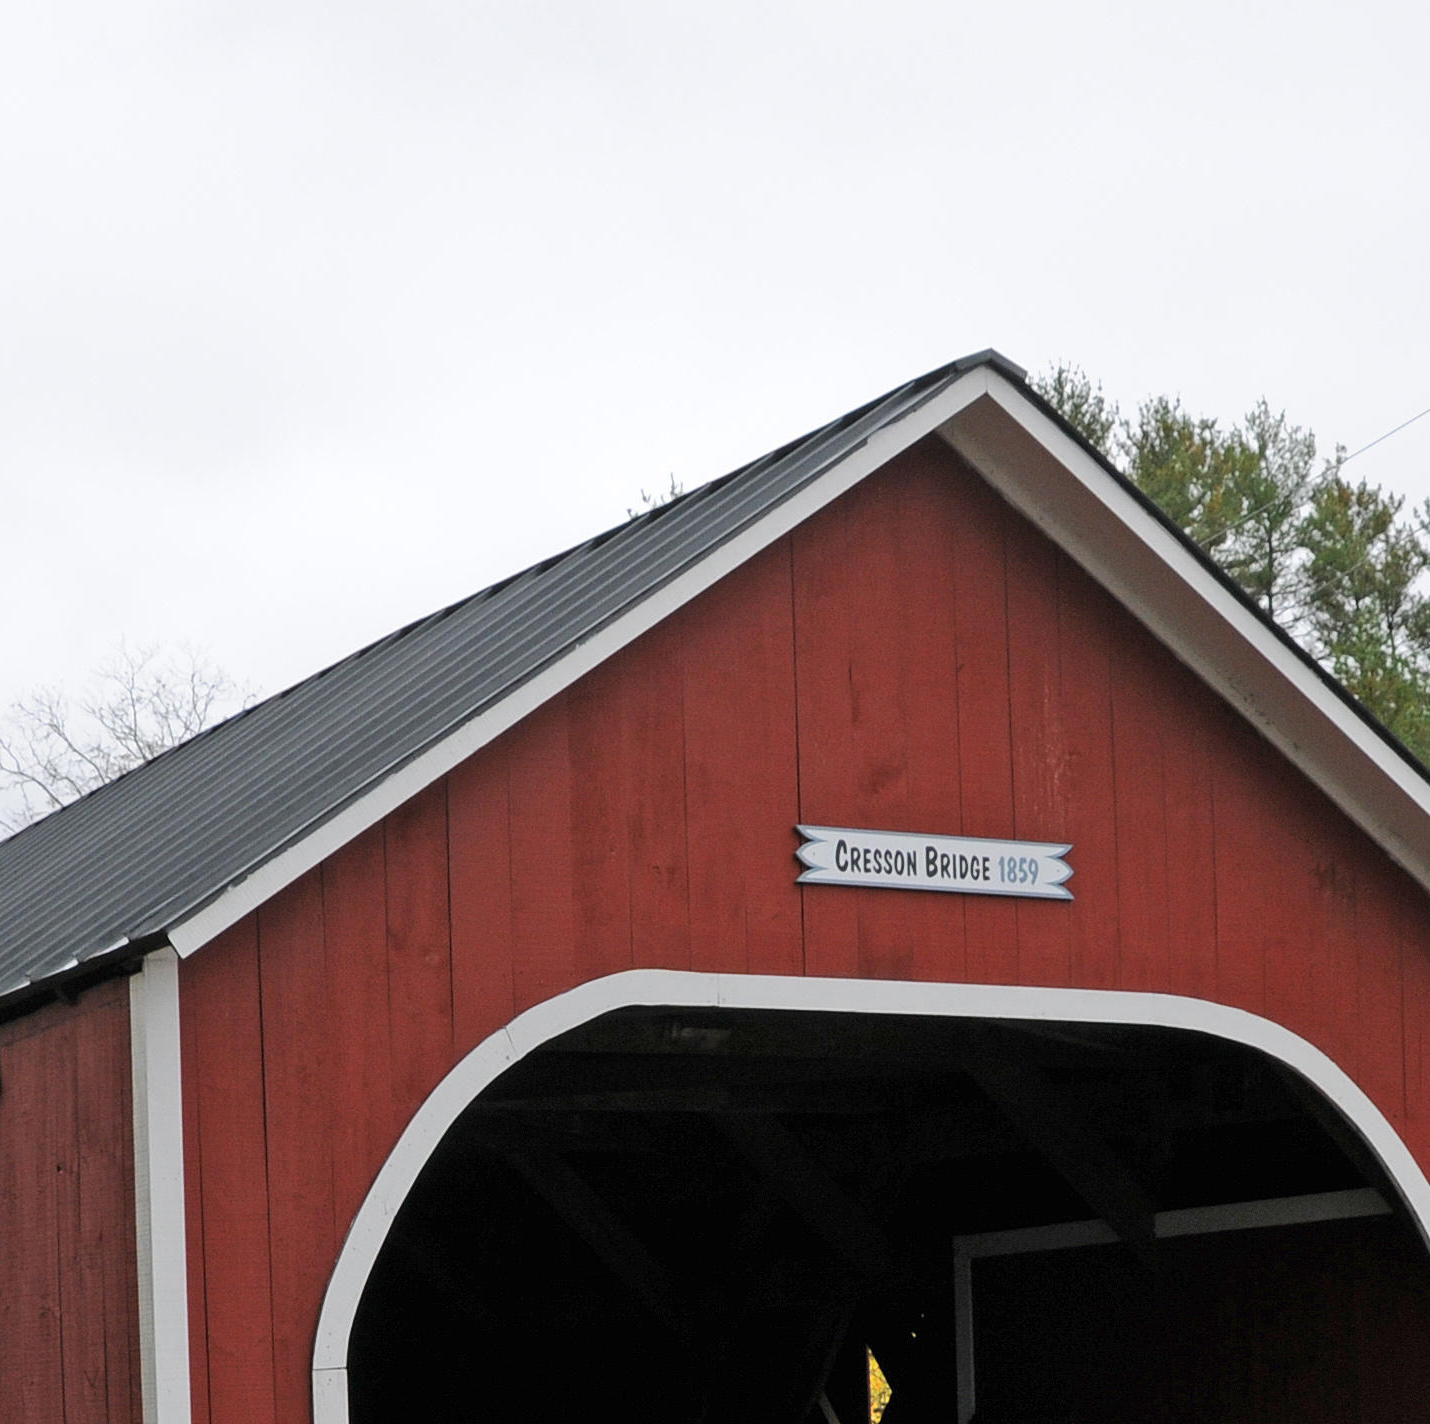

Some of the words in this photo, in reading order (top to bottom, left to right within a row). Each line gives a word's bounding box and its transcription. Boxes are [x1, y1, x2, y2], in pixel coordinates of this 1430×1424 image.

[835, 839, 917, 876] CRESSON
[925, 845, 991, 881] BRIDGE
[998, 856, 1039, 885] 1859
